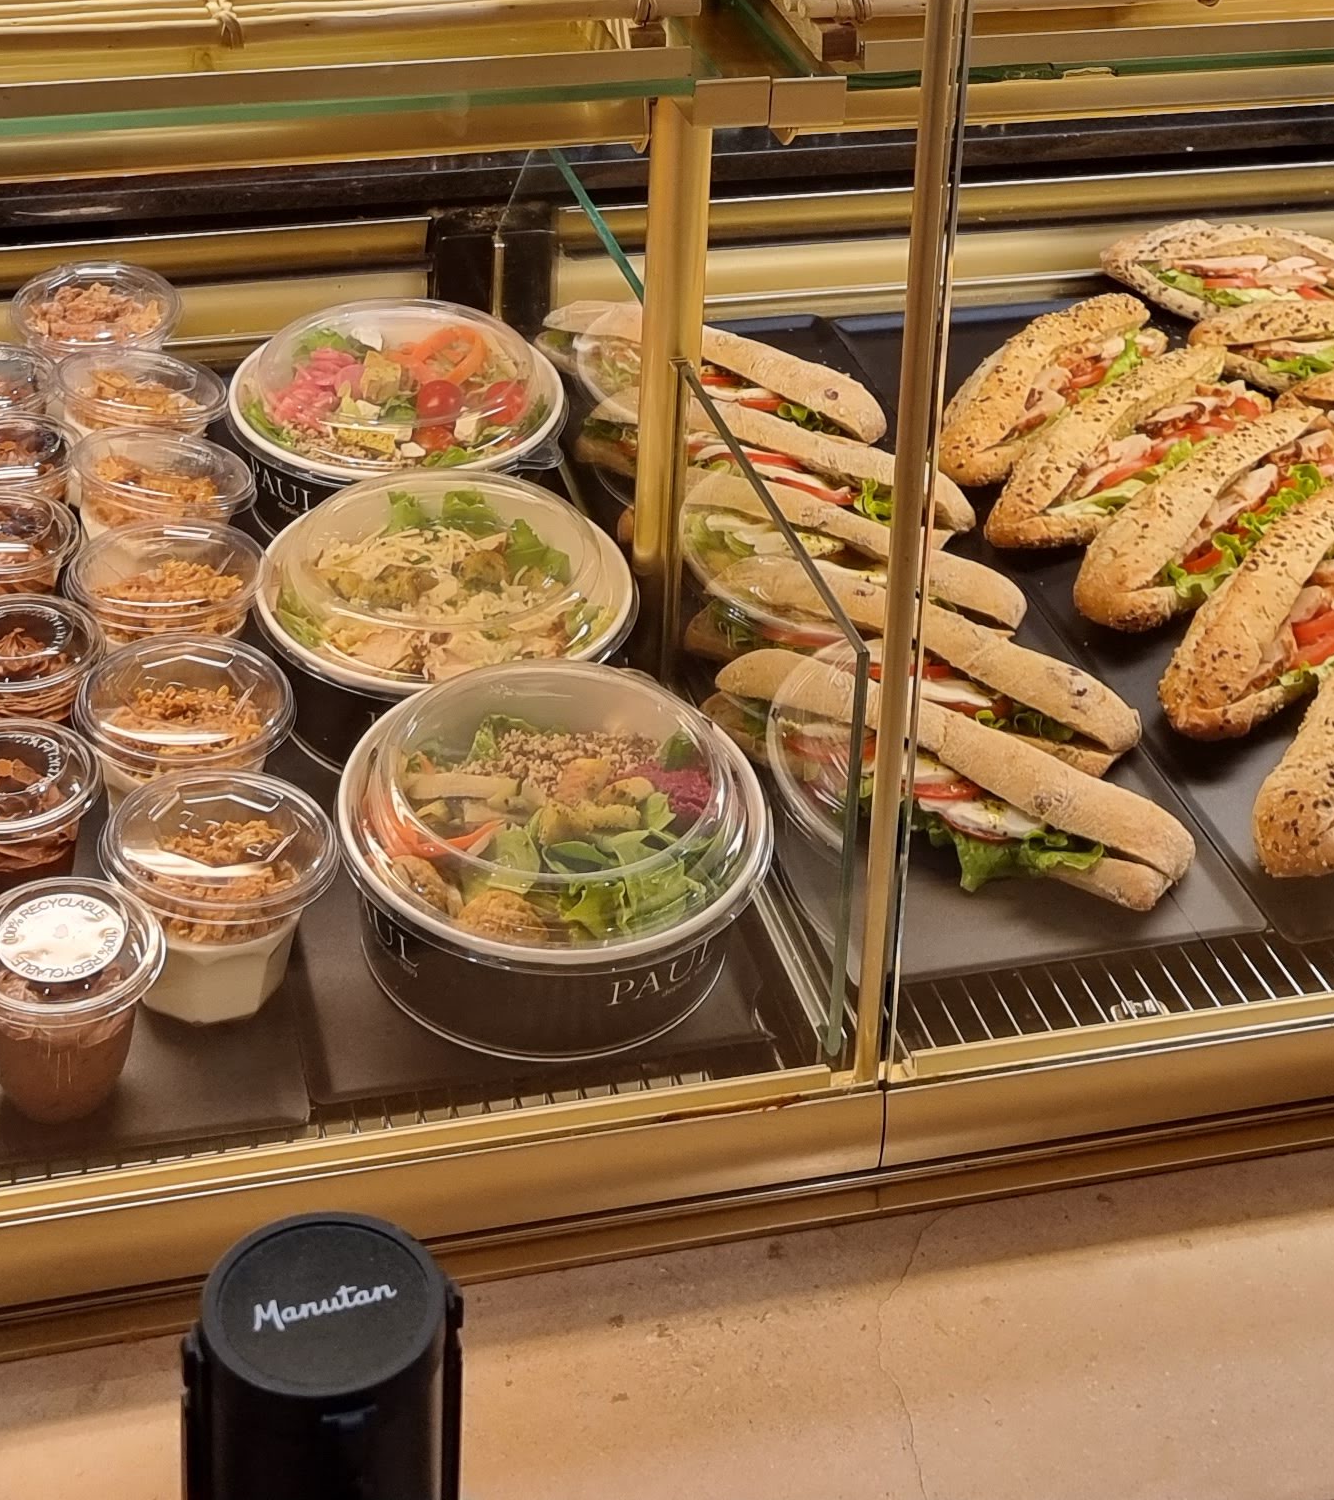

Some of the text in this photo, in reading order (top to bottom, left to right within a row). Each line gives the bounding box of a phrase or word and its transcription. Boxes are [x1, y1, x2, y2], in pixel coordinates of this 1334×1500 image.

[2, 898, 109, 945] 100% RECYCLABLE
[11, 929, 118, 978] 100% RECYCLABLE
[252, 1283, 398, 1332] Manutan
